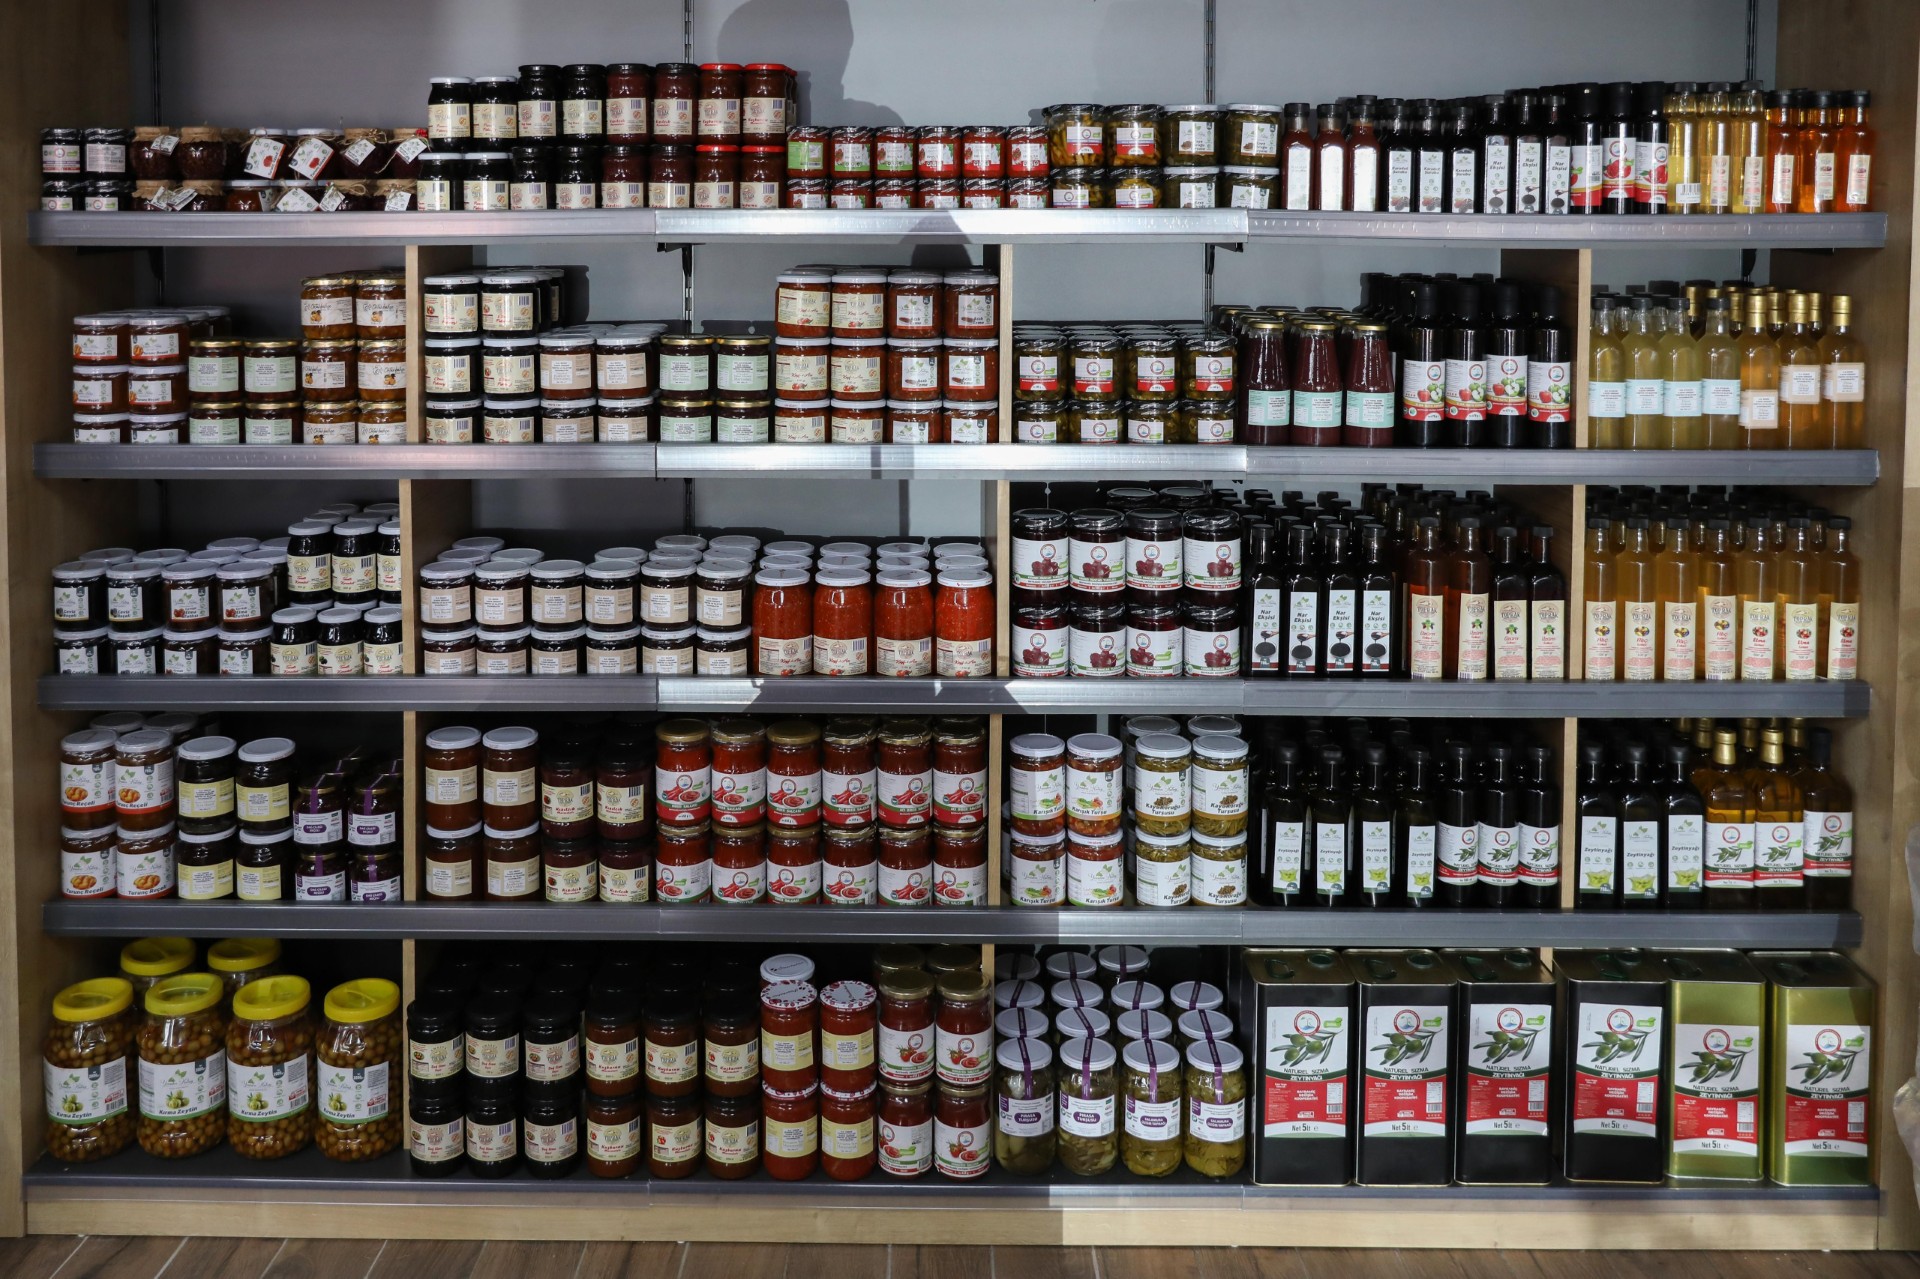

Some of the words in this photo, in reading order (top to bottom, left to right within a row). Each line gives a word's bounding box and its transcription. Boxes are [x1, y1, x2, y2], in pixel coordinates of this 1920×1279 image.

[177, 1106, 198, 1115] Zeytin
[257, 1109, 277, 1118] Zeytin
[336, 1109, 355, 1119] Zeytin
[72, 1112, 92, 1120] Zeytin
